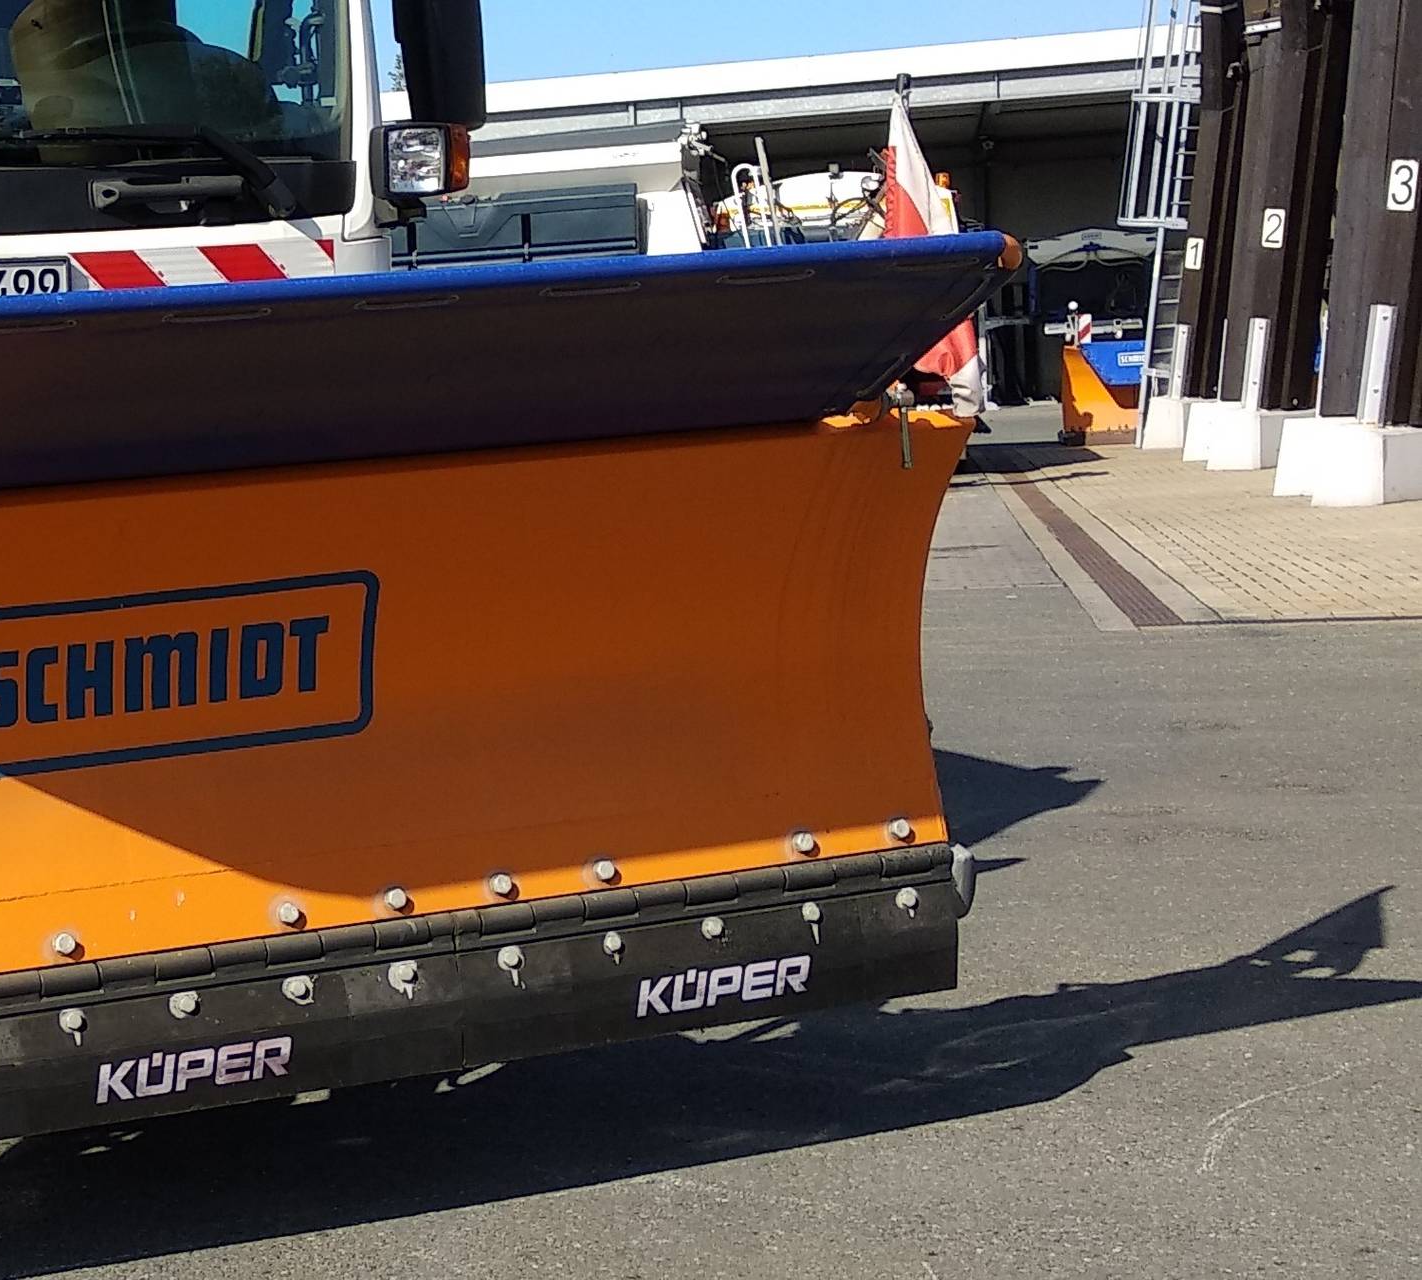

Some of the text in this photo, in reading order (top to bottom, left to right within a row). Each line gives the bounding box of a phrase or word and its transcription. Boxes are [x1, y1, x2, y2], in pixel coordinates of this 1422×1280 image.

[1391, 164, 1414, 205] 3
[1264, 213, 1283, 244] 2
[1189, 241, 1200, 266] 1
[636, 954, 812, 1019] KÜPER
[95, 1036, 293, 1105] KÜPER
